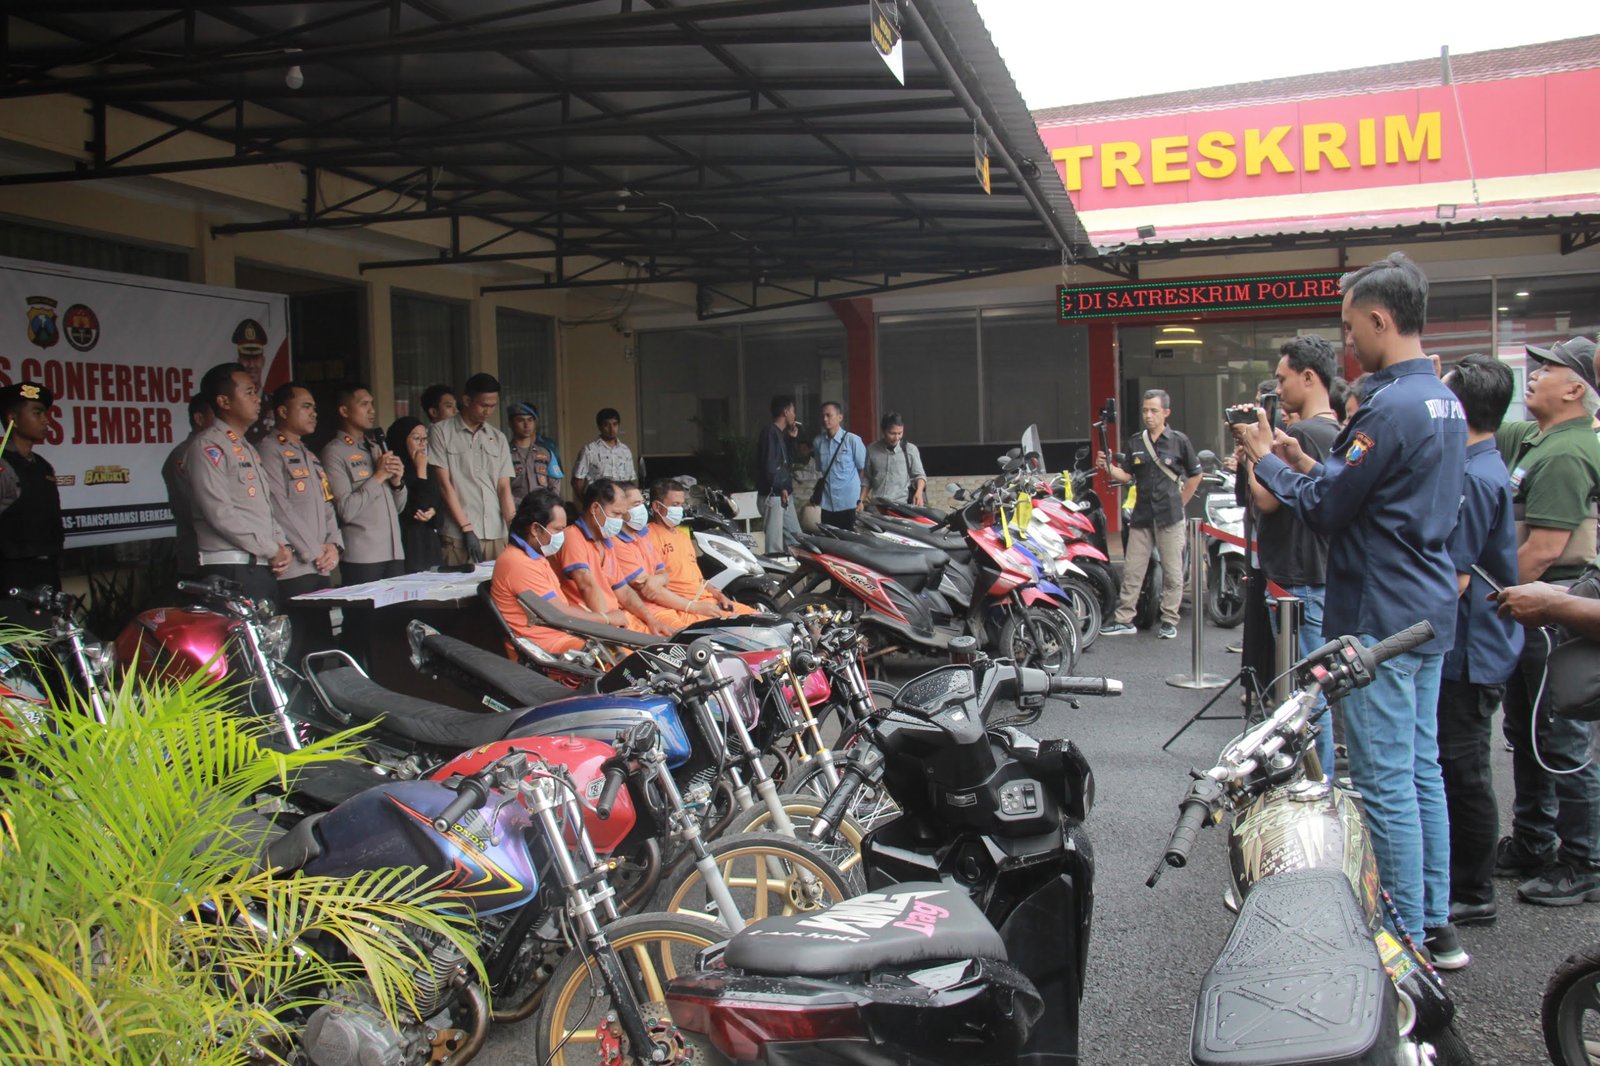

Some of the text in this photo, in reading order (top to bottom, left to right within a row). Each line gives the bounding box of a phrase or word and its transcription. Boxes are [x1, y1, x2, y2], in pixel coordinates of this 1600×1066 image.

[1051, 111, 1442, 192] TRESKRIM
[1078, 293, 1102, 310] DI
[1107, 284, 1251, 308] SATRESKRIM
[72, 406, 173, 445] JEMBER
[84, 468, 130, 485] BANGKIT
[892, 900, 950, 938] Drag
